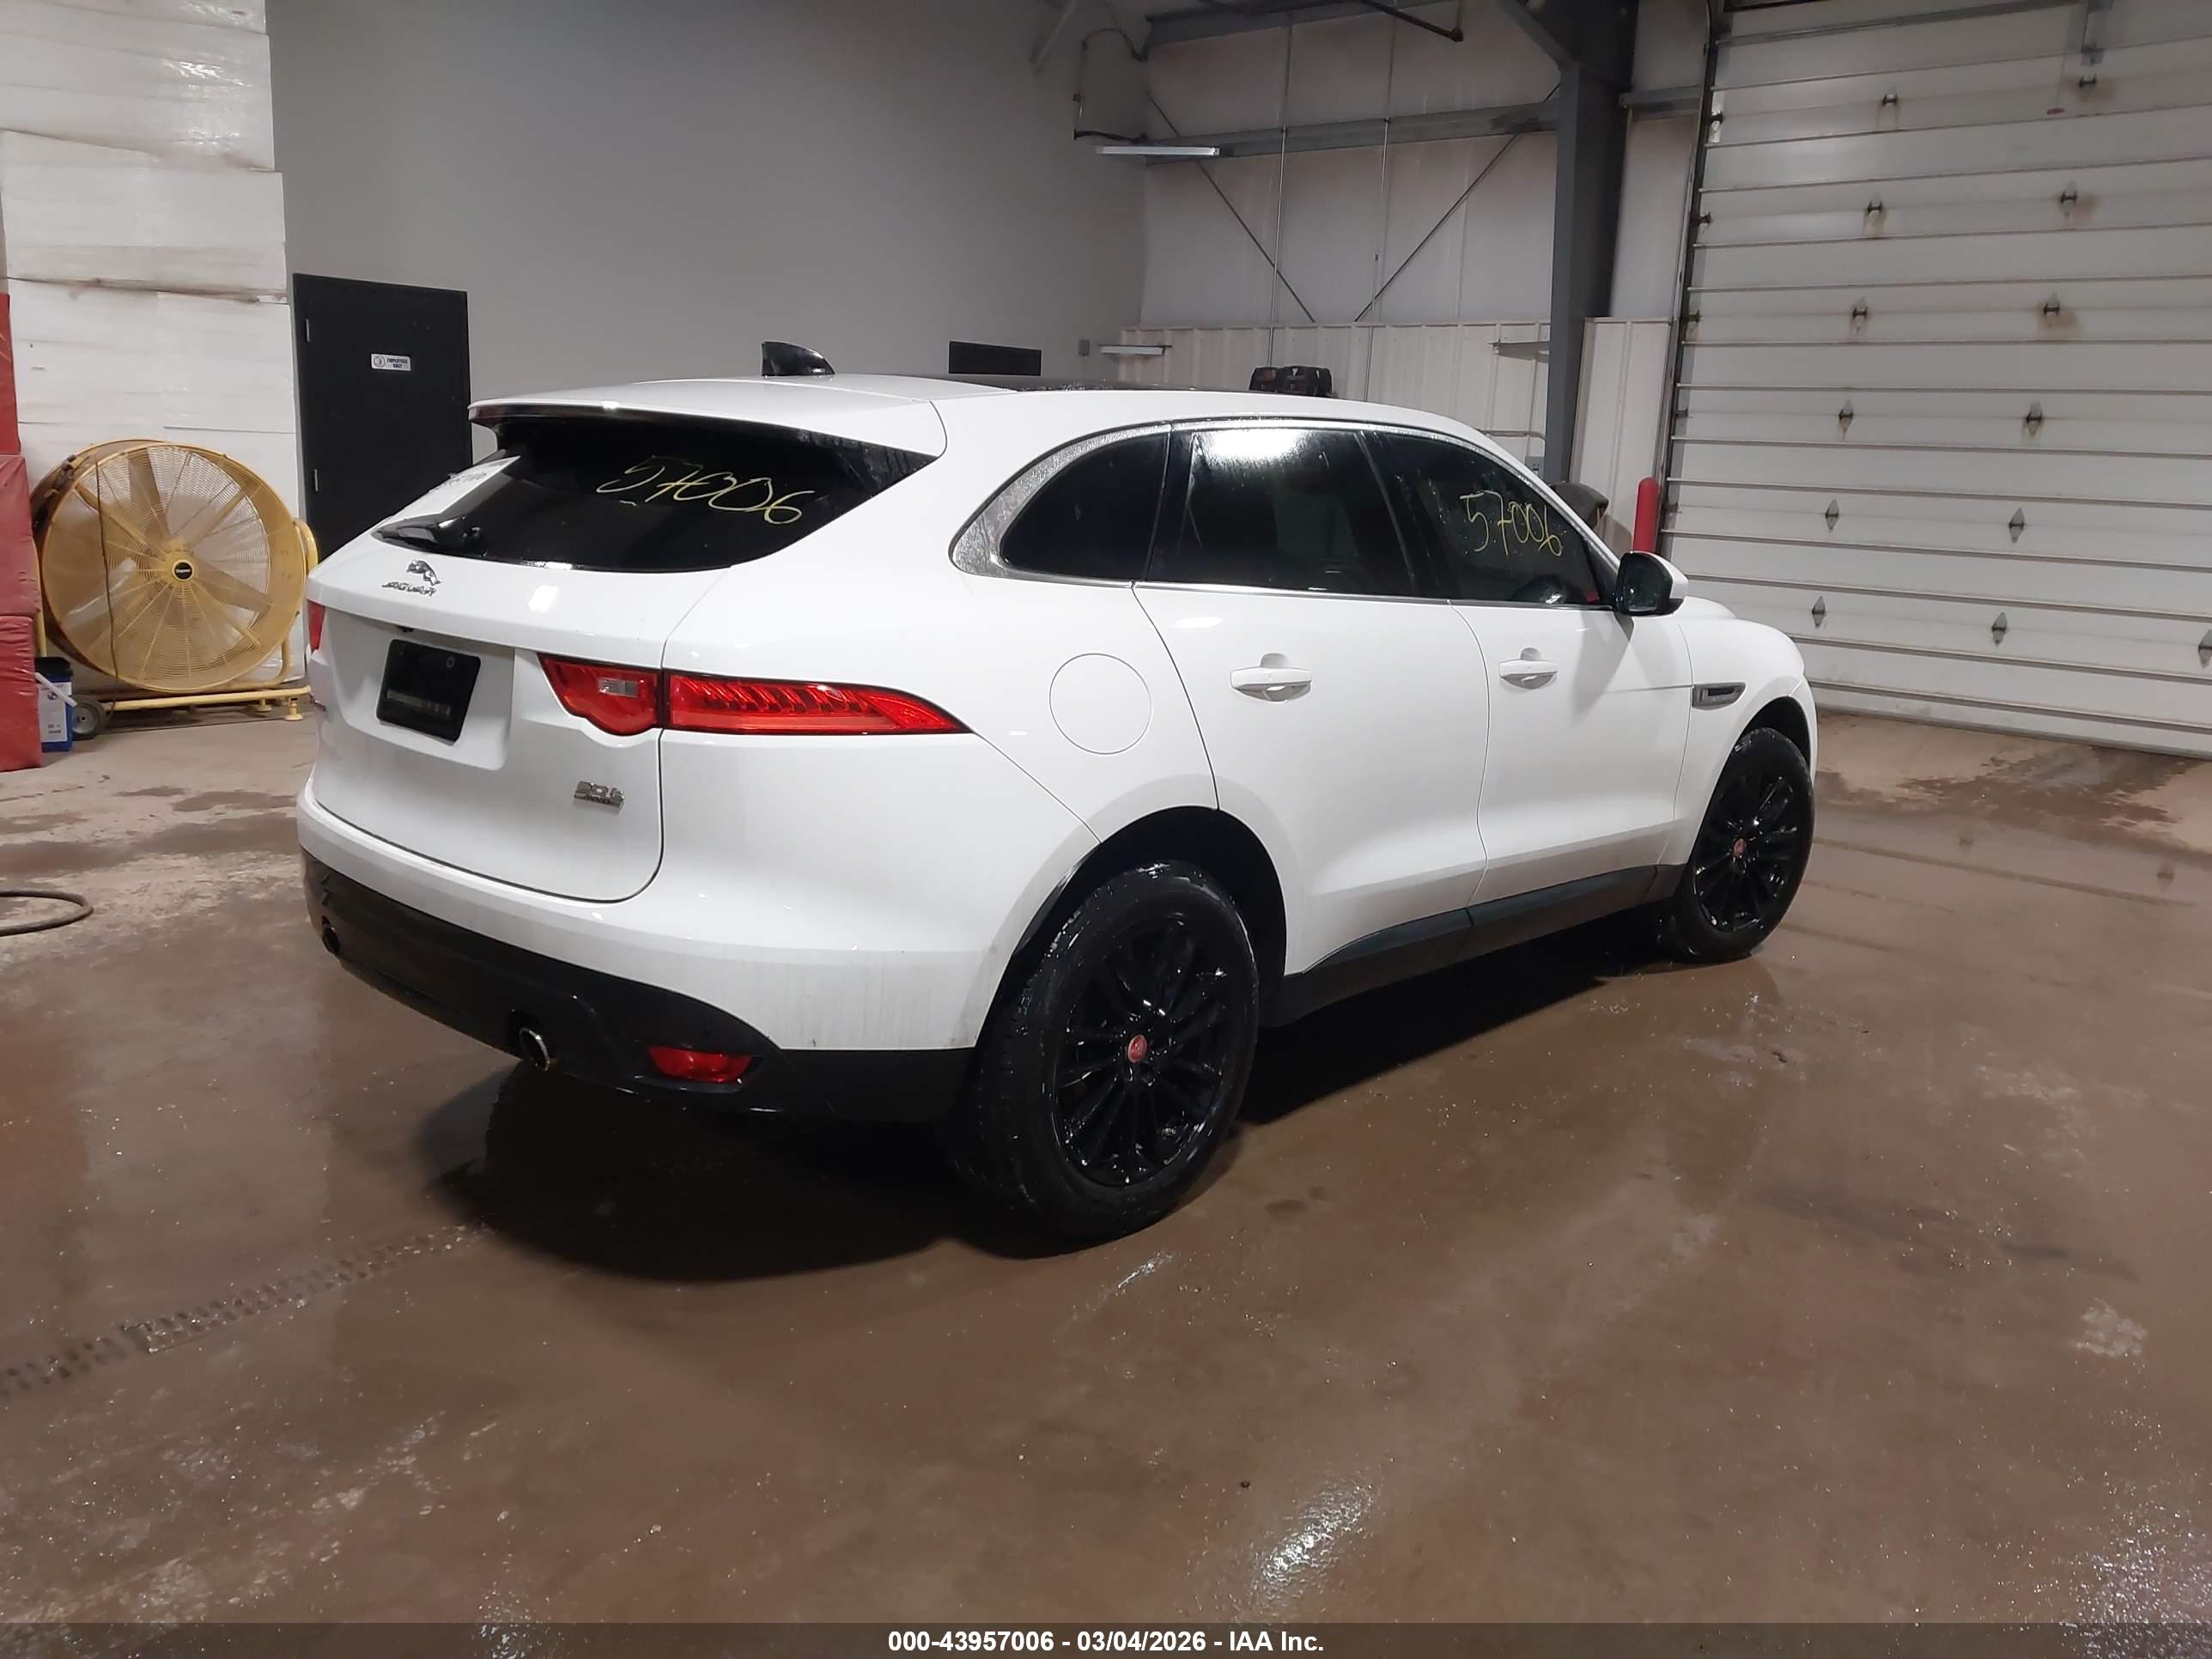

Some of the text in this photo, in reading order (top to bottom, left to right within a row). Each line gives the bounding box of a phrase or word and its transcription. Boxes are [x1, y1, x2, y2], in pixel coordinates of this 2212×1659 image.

[596, 454, 815, 525] 57006
[1459, 489, 1563, 557] 57006
[381, 581, 437, 597] JAGUAR
